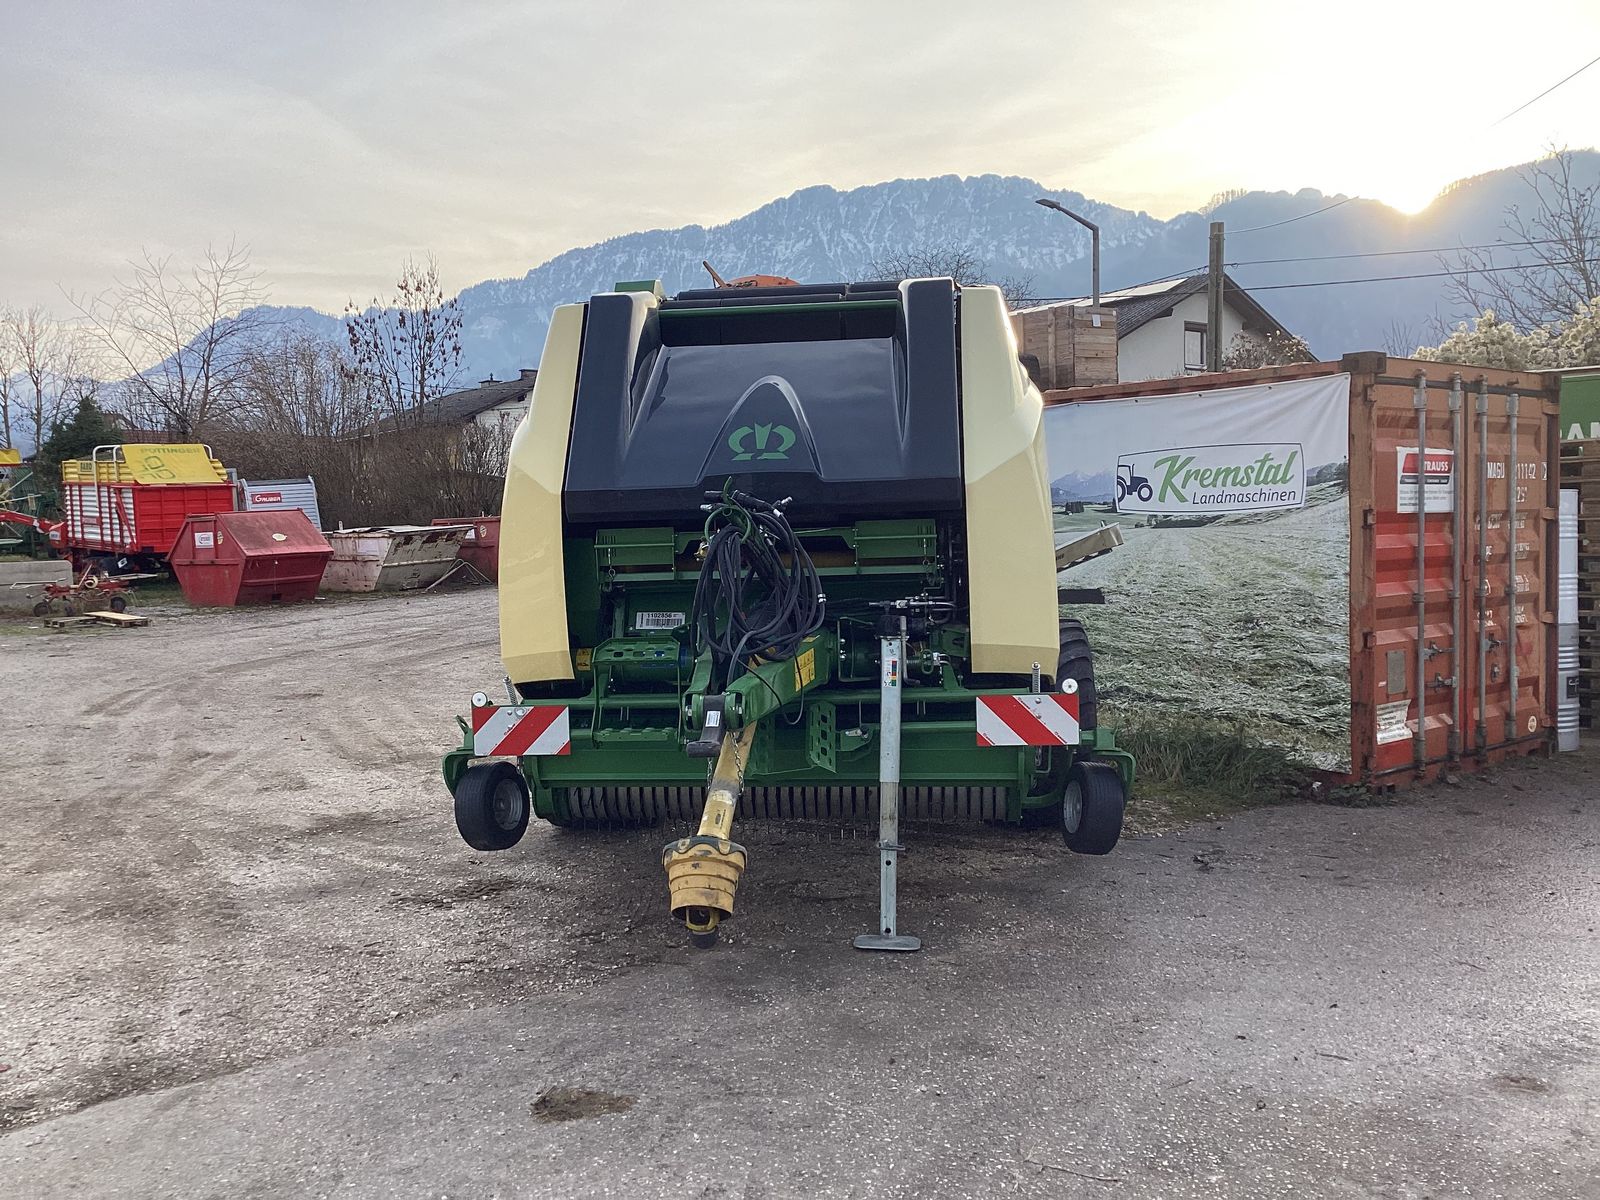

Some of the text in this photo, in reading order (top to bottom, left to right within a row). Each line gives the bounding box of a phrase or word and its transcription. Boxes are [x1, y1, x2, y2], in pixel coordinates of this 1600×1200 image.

[1424, 461, 1449, 471] TRAUSS
[1153, 450, 1298, 503] Kremstal
[1192, 488, 1296, 505] Landmaschinen
